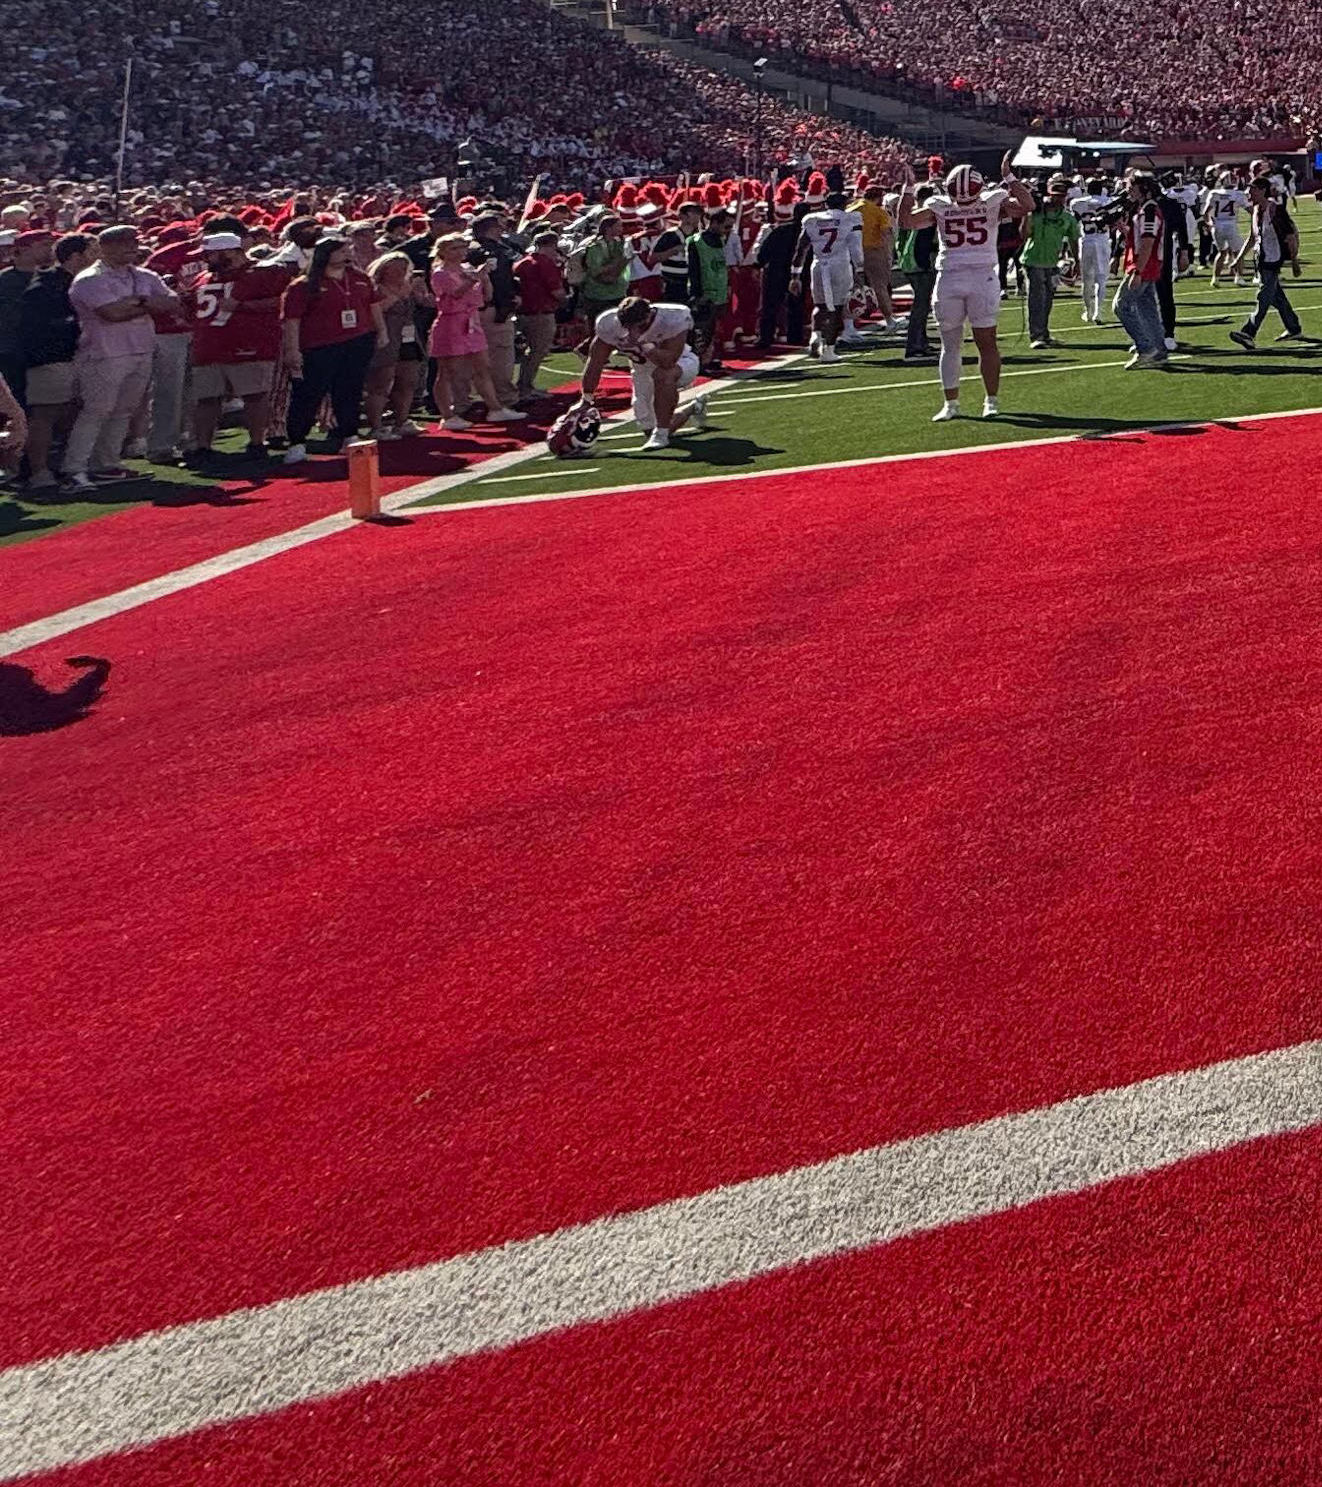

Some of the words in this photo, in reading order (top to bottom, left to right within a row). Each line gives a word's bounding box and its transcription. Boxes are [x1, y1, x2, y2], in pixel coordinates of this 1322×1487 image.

[1213, 200, 1236, 217] 14
[818, 227, 838, 254] 7
[944, 216, 989, 248] 55
